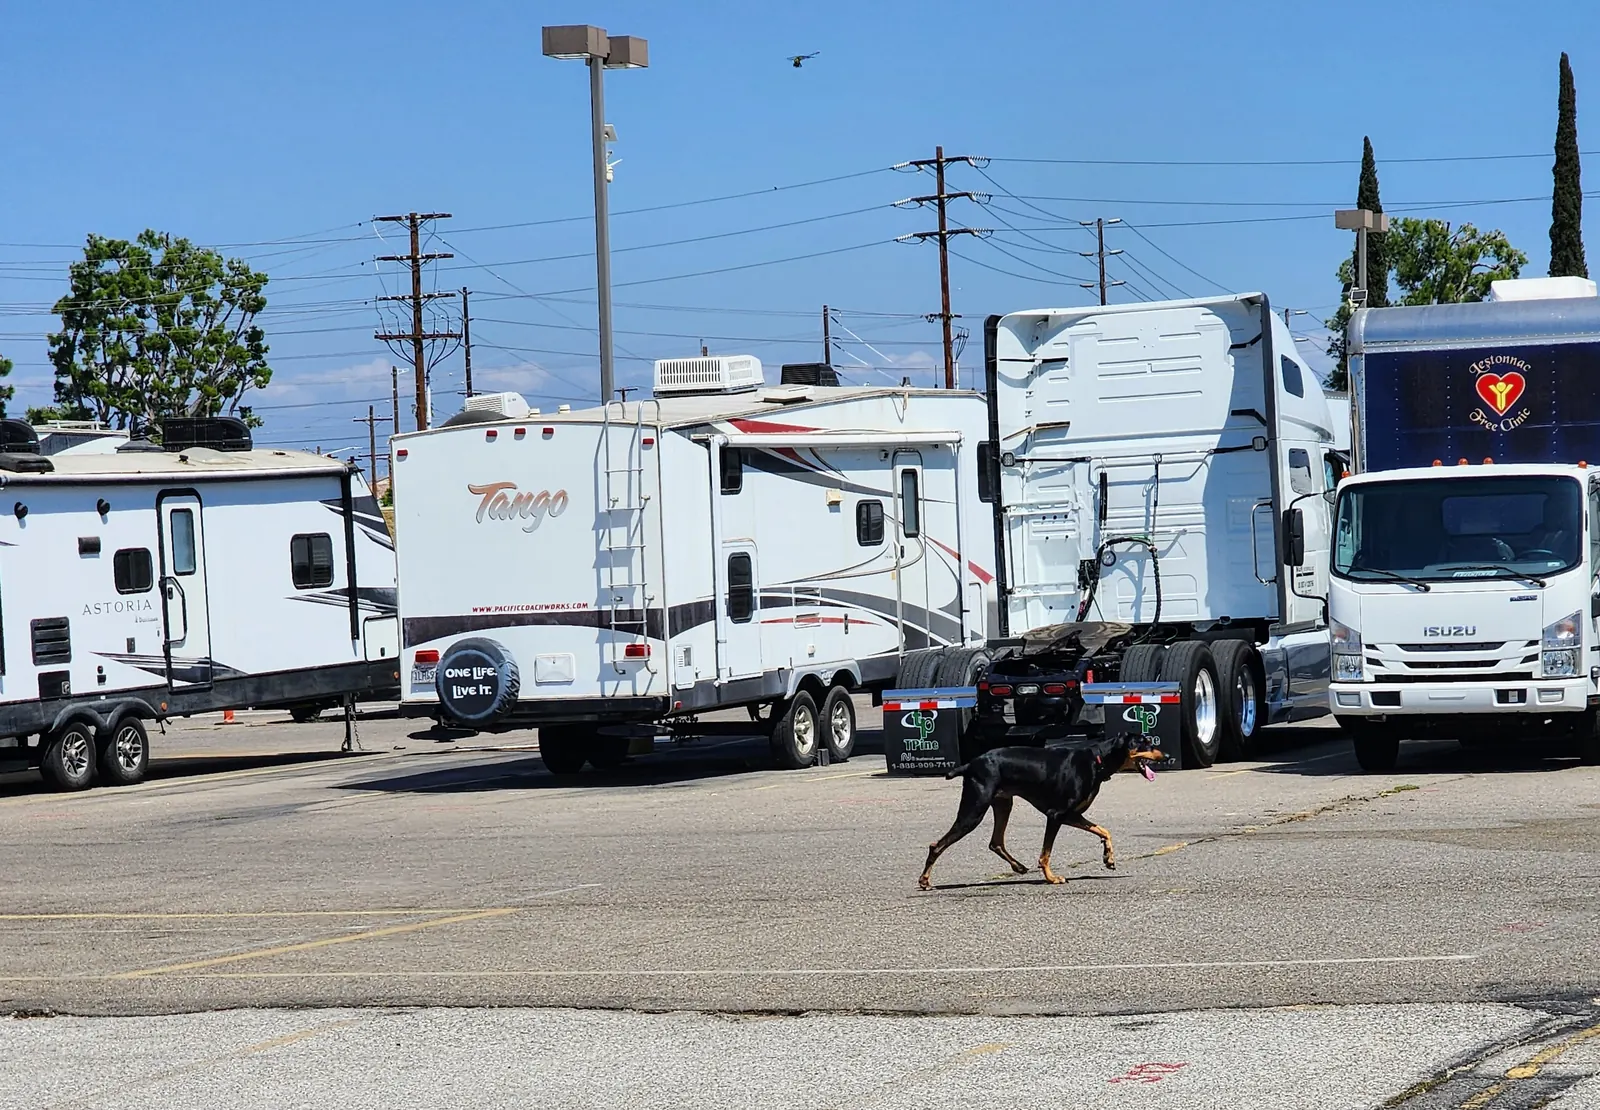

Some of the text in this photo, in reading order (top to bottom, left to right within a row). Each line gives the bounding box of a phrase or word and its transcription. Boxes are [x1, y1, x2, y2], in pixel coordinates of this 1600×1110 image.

[1469, 407, 1531, 432] Free Clinic
[467, 481, 570, 534] Tango
[82, 599, 153, 616] ASTORIA
[472, 602, 589, 613] WWW.PACIFICCOACHWORKS.COM
[1423, 625, 1477, 637] ISUZU
[903, 738, 939, 751] TPine
[891, 761, 956, 770] 1-888-909-7117
